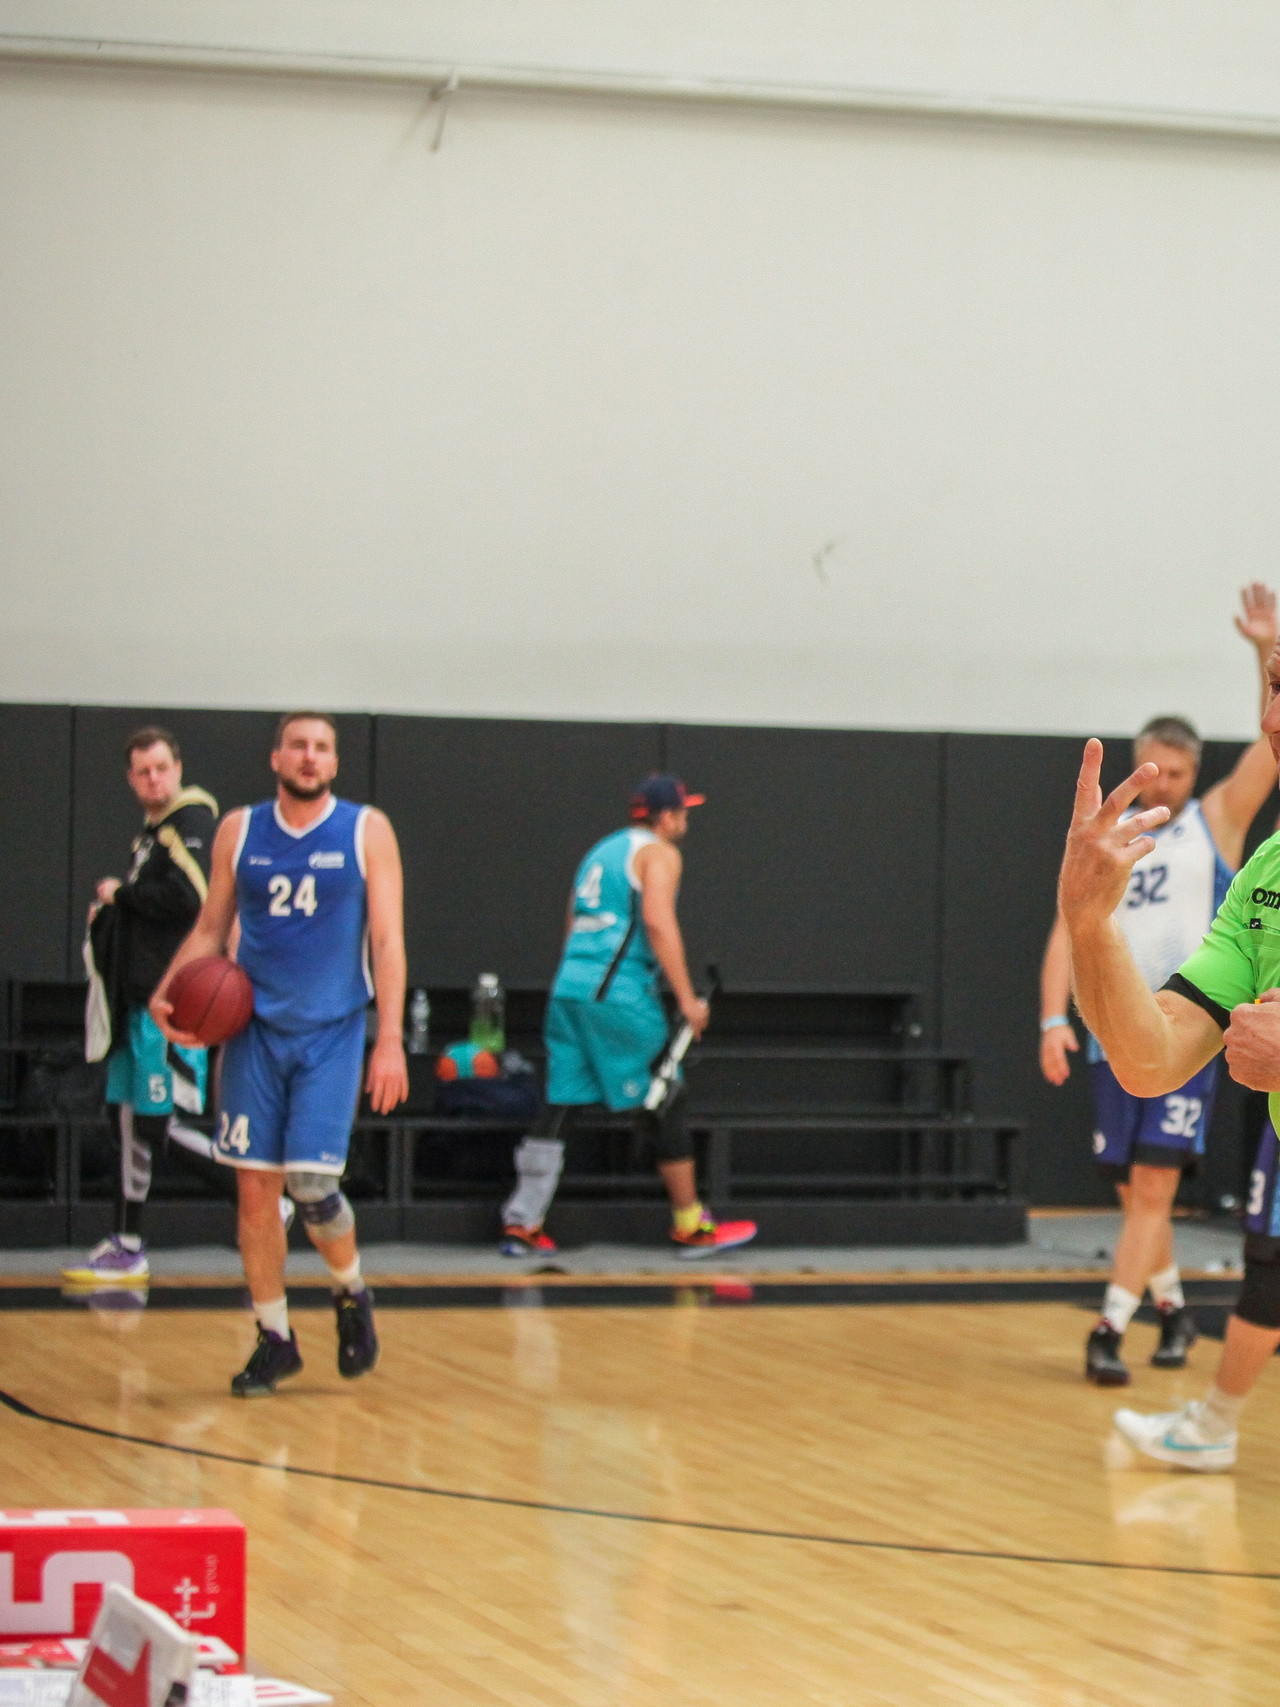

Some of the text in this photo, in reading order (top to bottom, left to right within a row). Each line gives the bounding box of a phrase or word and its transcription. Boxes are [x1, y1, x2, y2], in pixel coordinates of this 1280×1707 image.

[268, 873, 318, 917] 24
[577, 863, 603, 908] 4
[1127, 865, 1169, 909] 32
[148, 1074, 168, 1103] 5
[1160, 1094, 1203, 1138] 32
